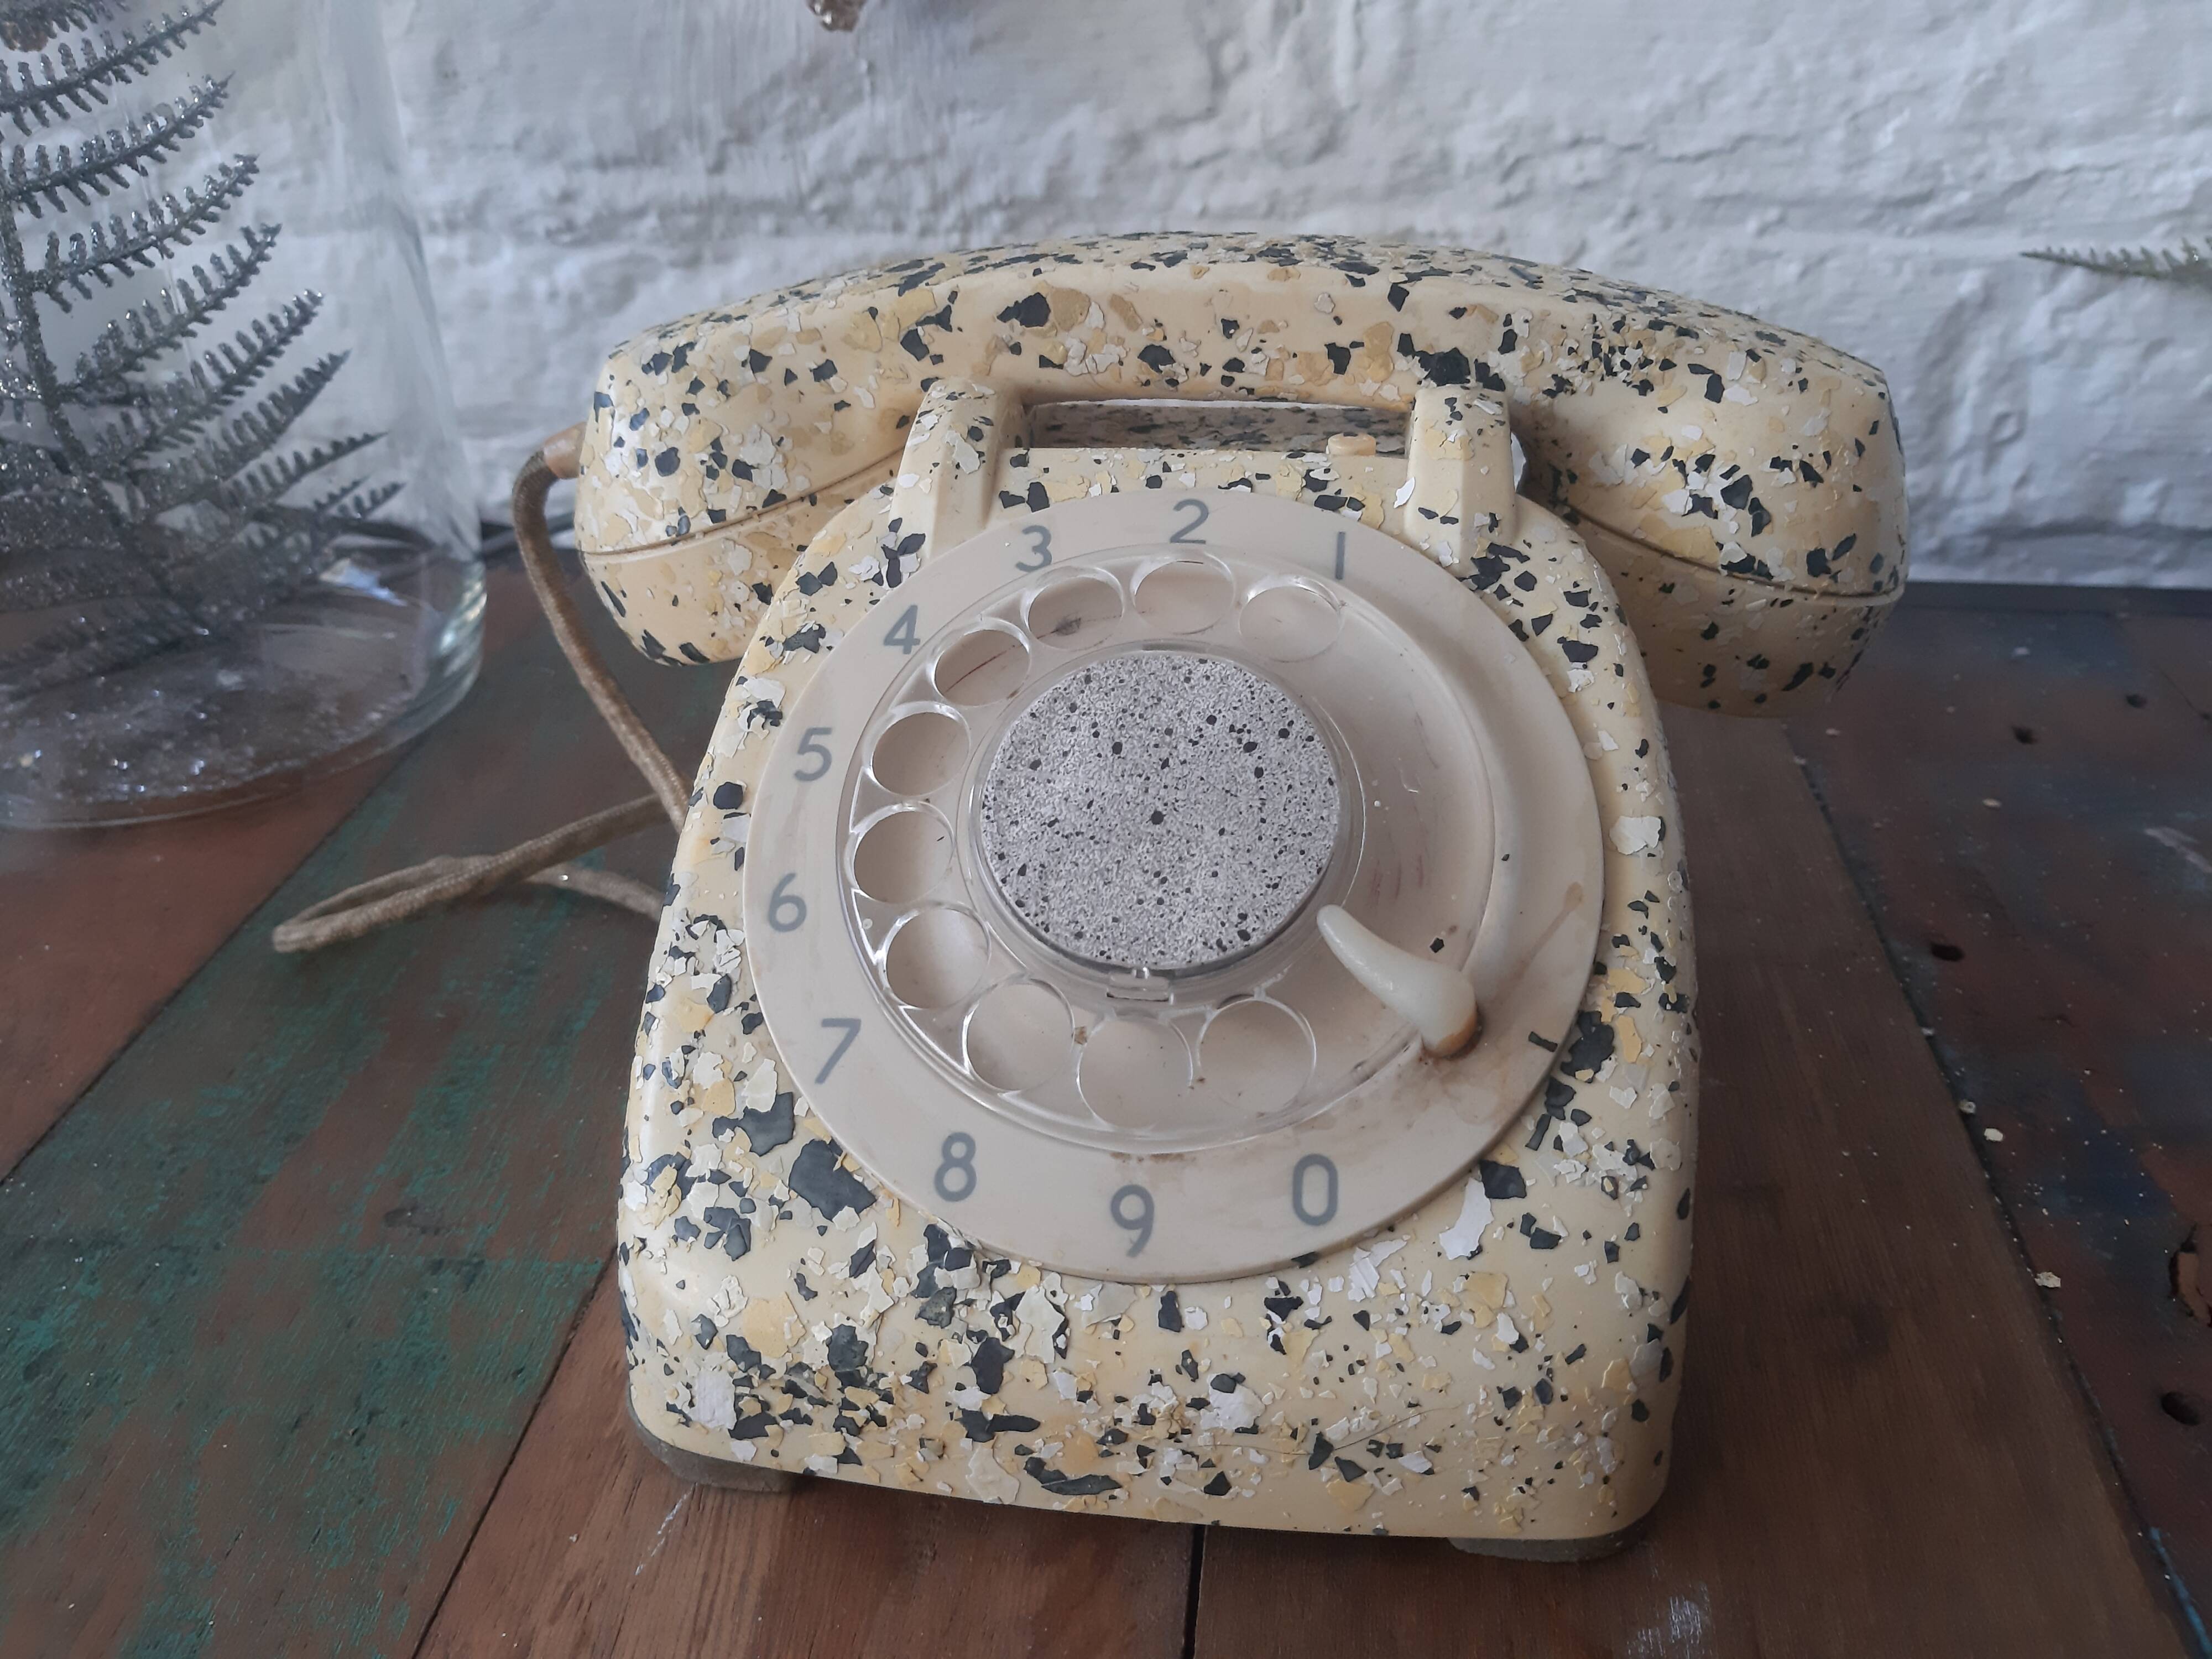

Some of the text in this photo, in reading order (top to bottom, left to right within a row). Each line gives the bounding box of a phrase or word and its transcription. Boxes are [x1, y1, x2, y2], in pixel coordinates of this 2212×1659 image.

[1015, 525, 1052, 573] 3
[1170, 499, 1209, 544] 2
[1335, 531, 1345, 580] 1
[883, 605, 920, 655] 4
[794, 727, 832, 782] 5
[767, 873, 807, 932] 6
[815, 1018, 861, 1084] 7
[934, 1131, 977, 1202] 8
[1292, 1154, 1338, 1226] 0
[1110, 1184, 1155, 1258] 9
